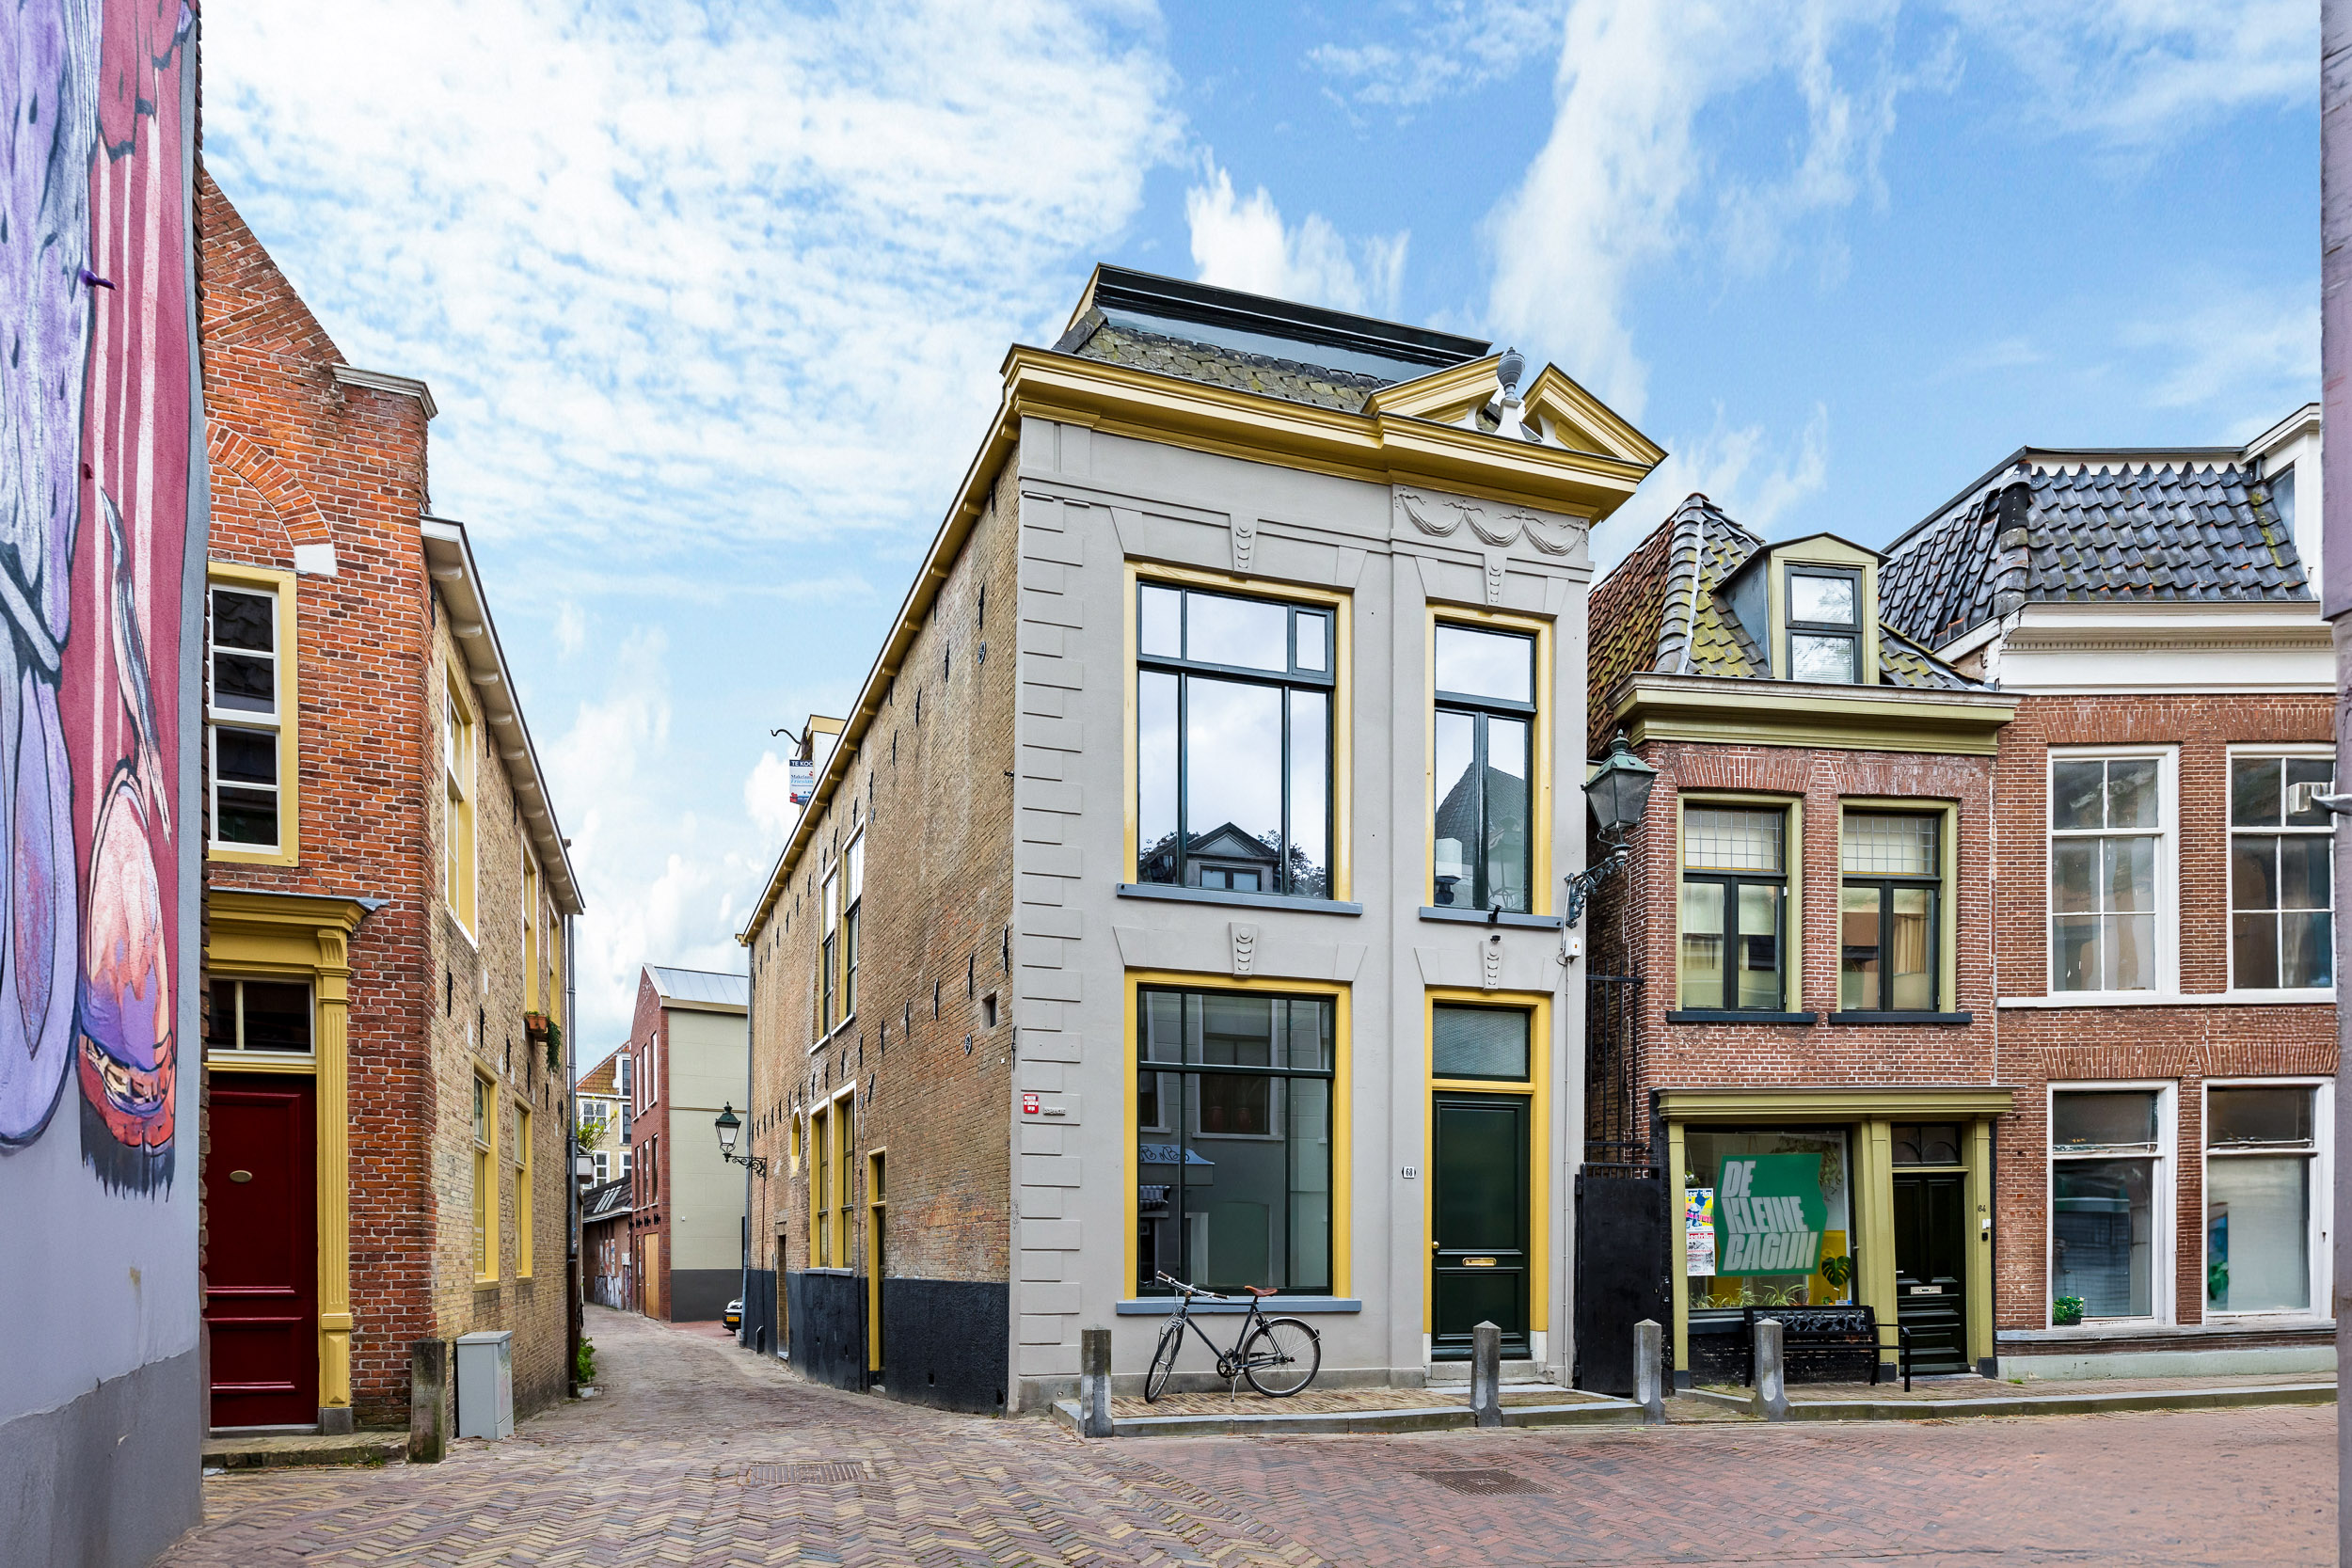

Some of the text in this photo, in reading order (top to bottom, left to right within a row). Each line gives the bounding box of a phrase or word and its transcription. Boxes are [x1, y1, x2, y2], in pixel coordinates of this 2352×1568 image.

[1406, 1167, 1413, 1177] 68
[1721, 1161, 1756, 1197] DE
[1721, 1196, 1809, 1234] KLEINE
[1978, 1204, 1986, 1212] 64
[1723, 1232, 1819, 1271] BAGIJN
